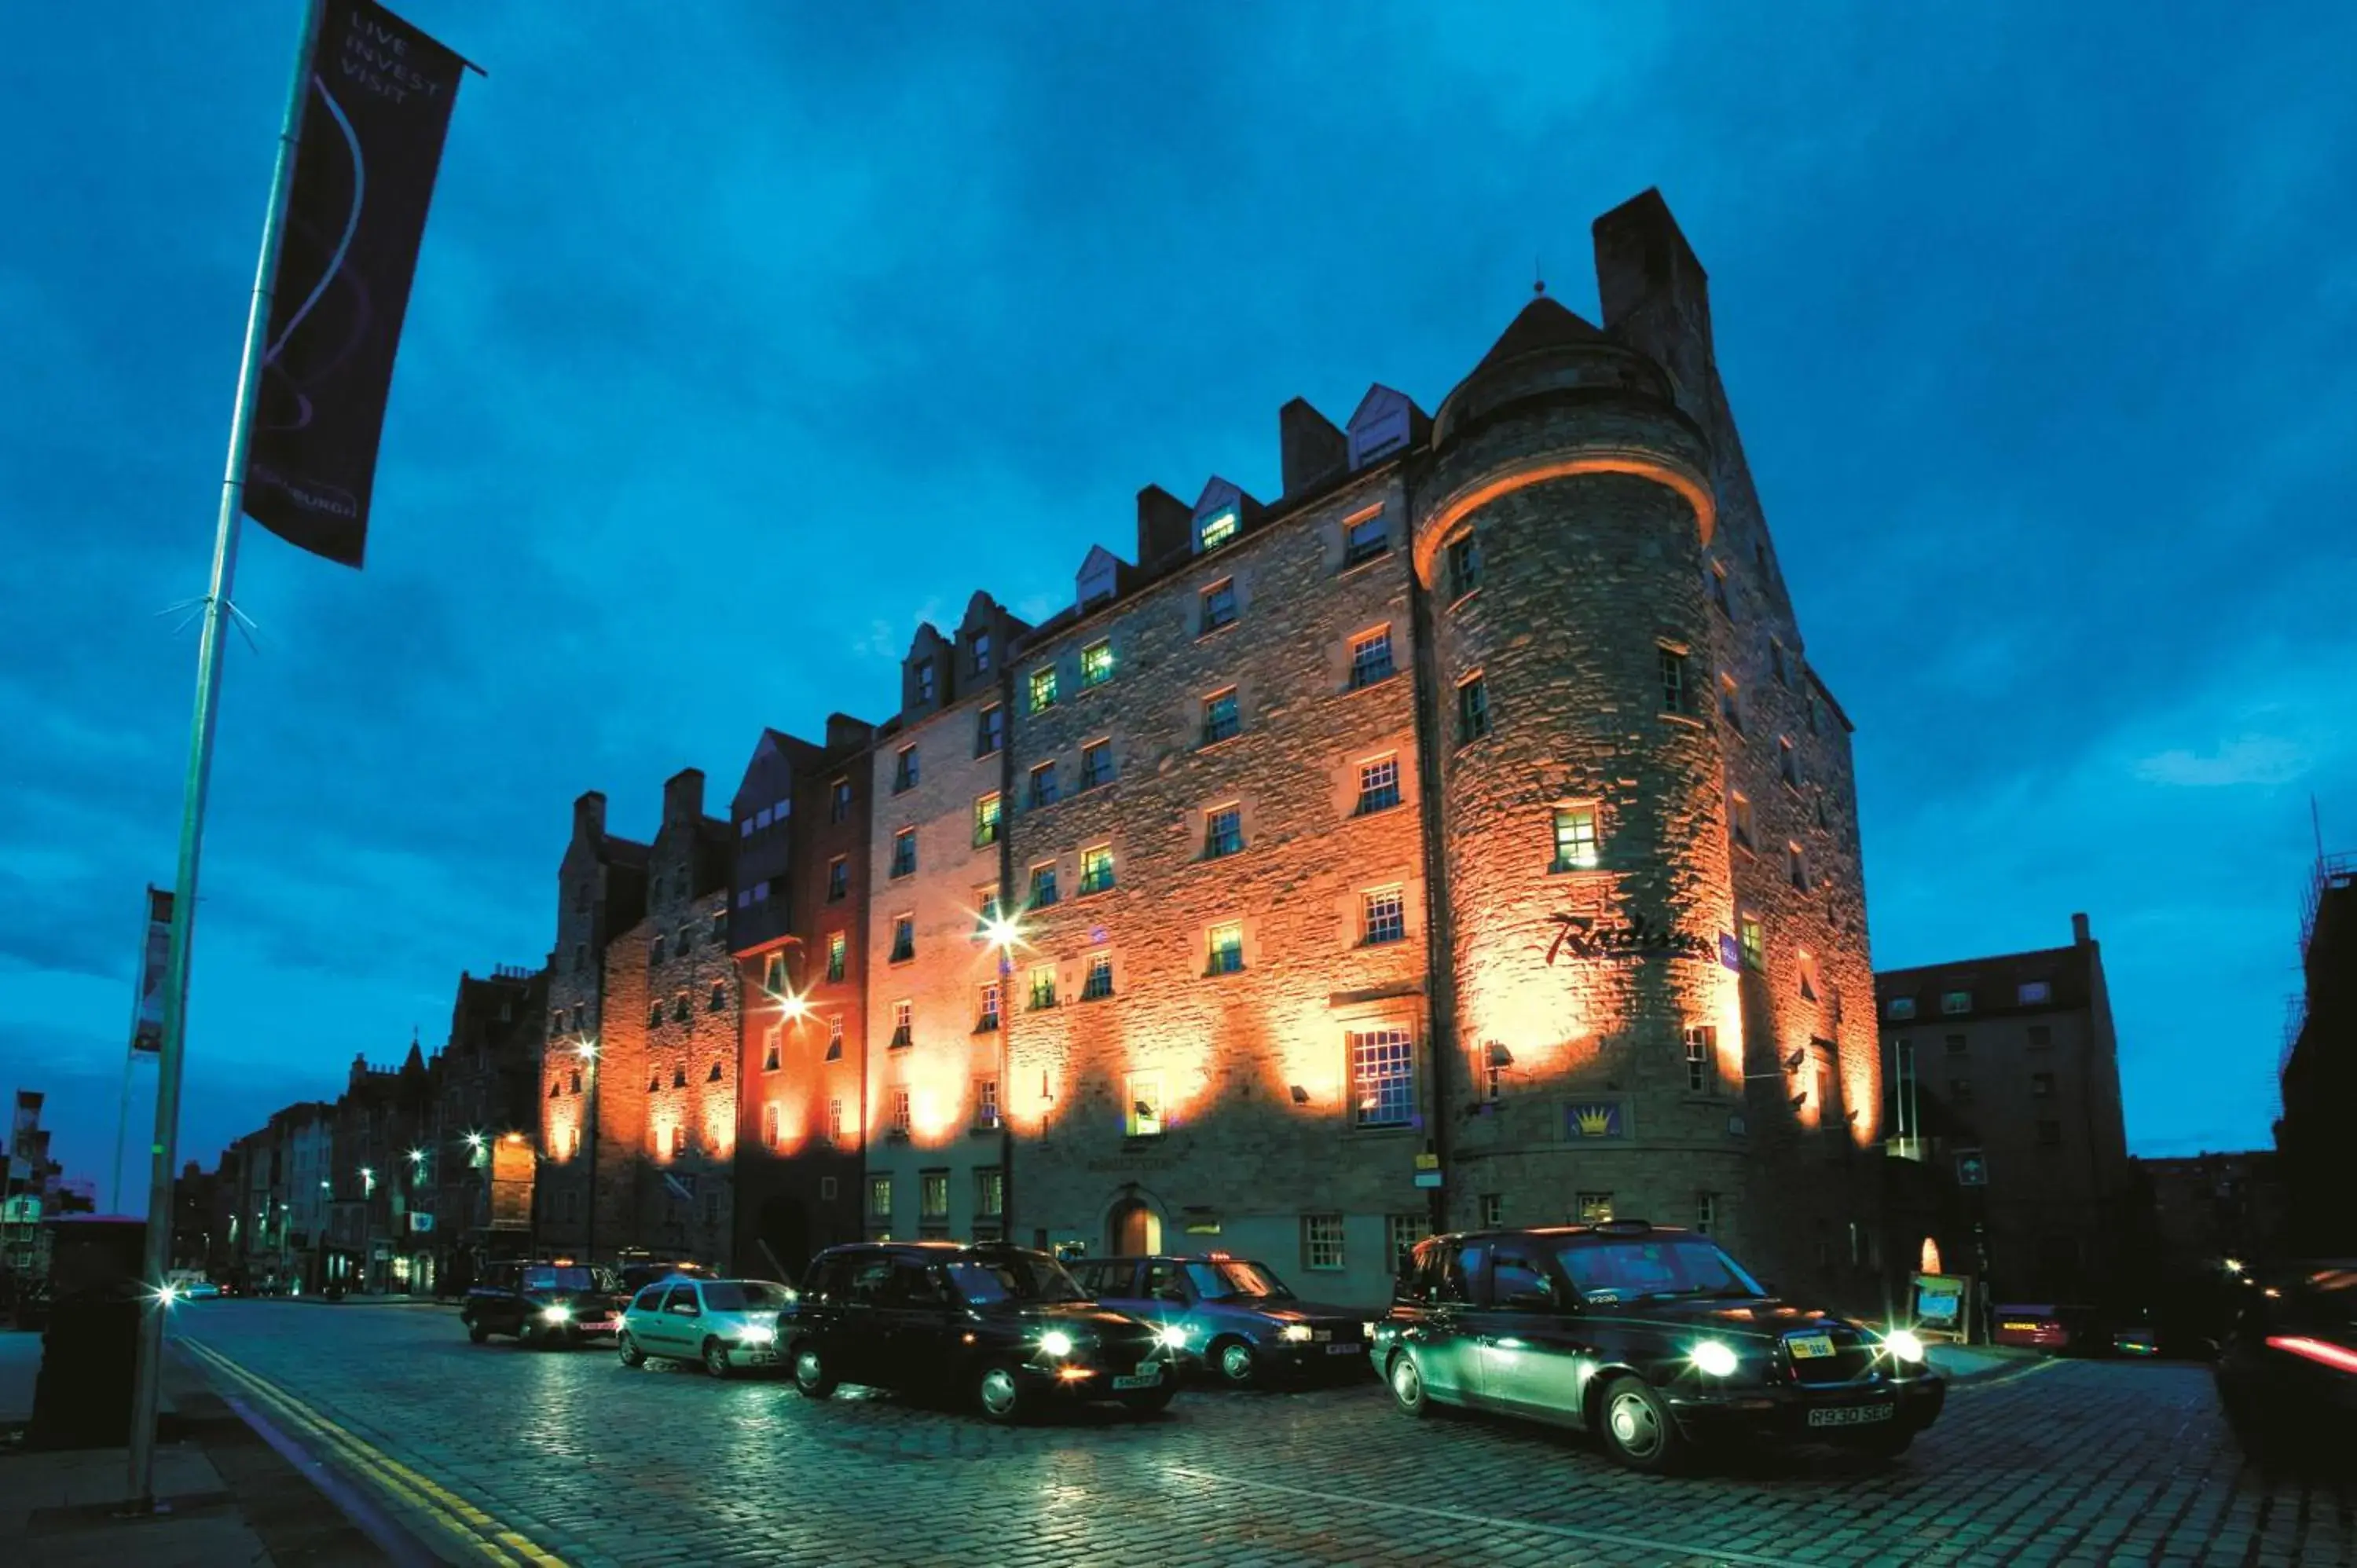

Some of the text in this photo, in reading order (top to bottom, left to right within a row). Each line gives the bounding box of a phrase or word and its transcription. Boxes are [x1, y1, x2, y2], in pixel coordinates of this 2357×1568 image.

[351, 10, 408, 57] LIVE
[341, 56, 408, 105] VISIT
[346, 35, 442, 97] INVEST
